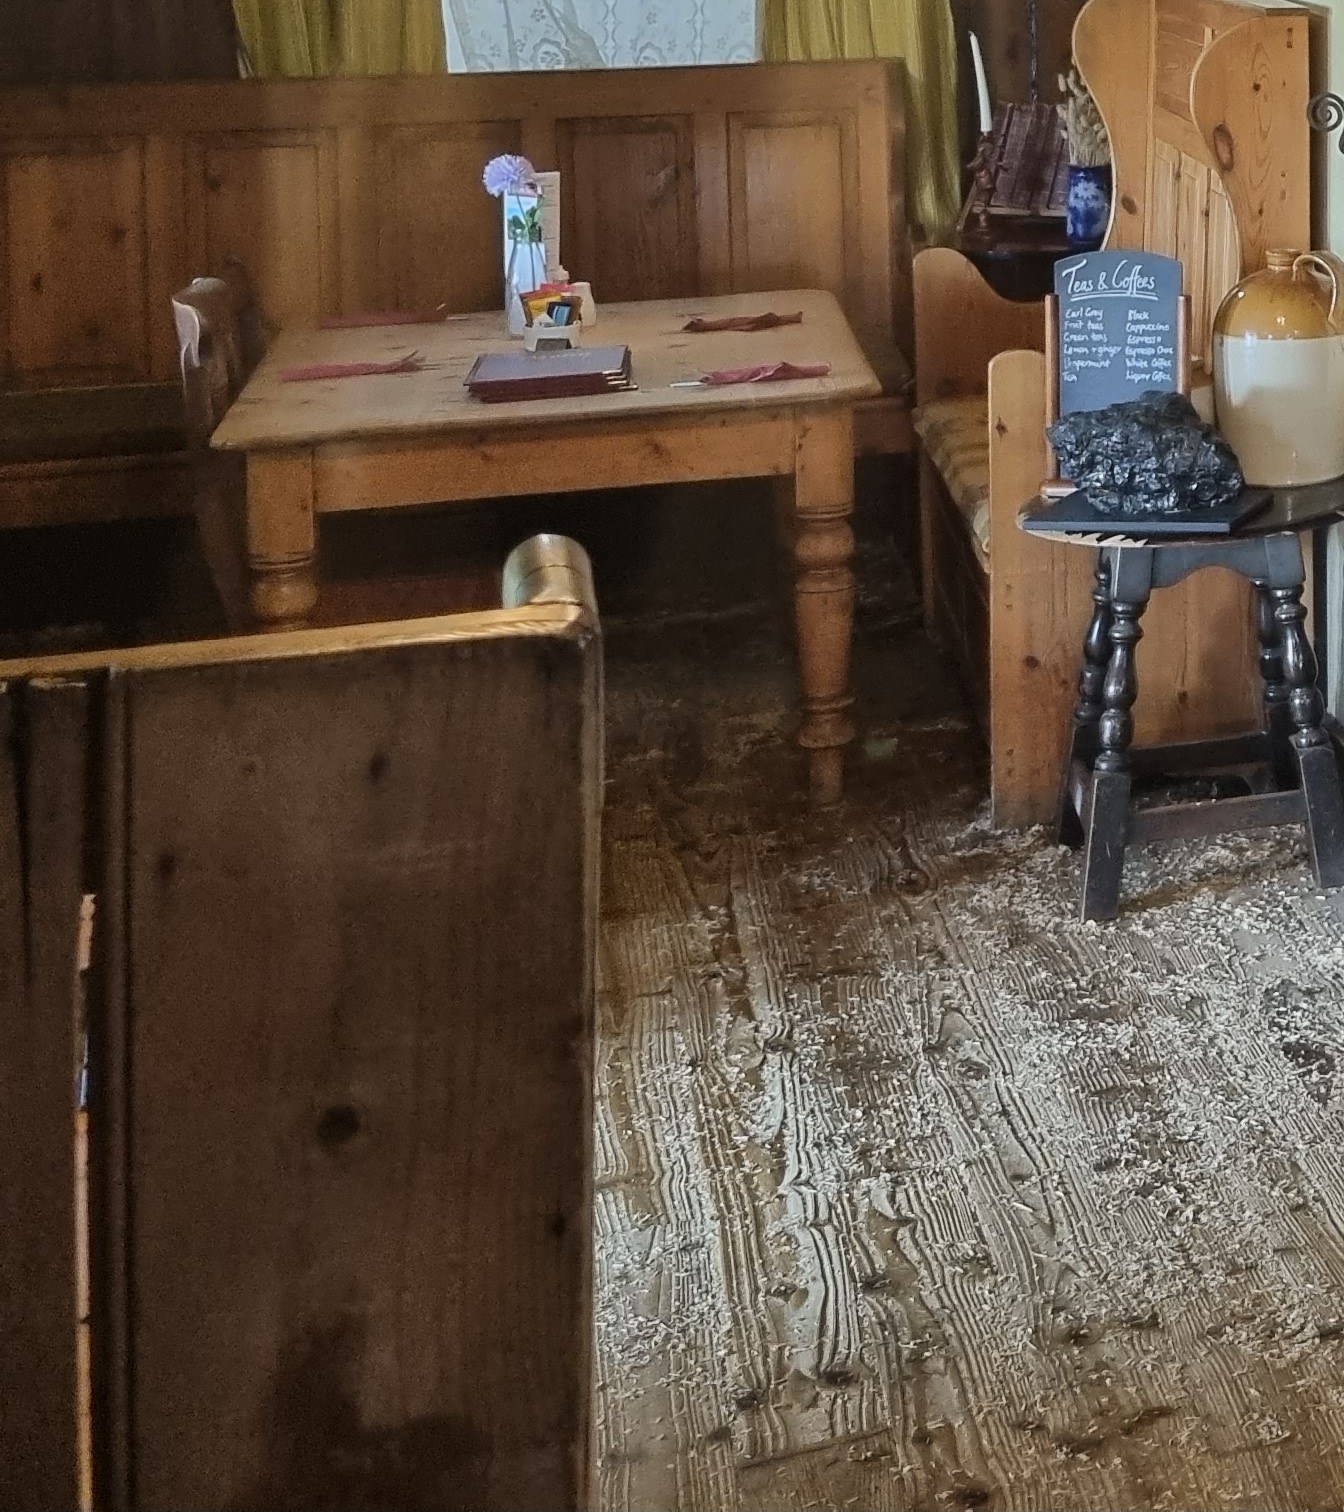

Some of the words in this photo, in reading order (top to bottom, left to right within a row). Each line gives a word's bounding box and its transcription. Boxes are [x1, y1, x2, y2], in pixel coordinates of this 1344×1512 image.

[1061, 258, 1094, 294] Teas
[1097, 271, 1108, 290] &
[1112, 259, 1156, 295] Coffees
[1065, 306, 1083, 319] Earl
[1127, 309, 1150, 321] Black
[1063, 331, 1089, 342] Green
[1127, 334, 1162, 345] Espresso
[1063, 343, 1089, 355] Lemon
